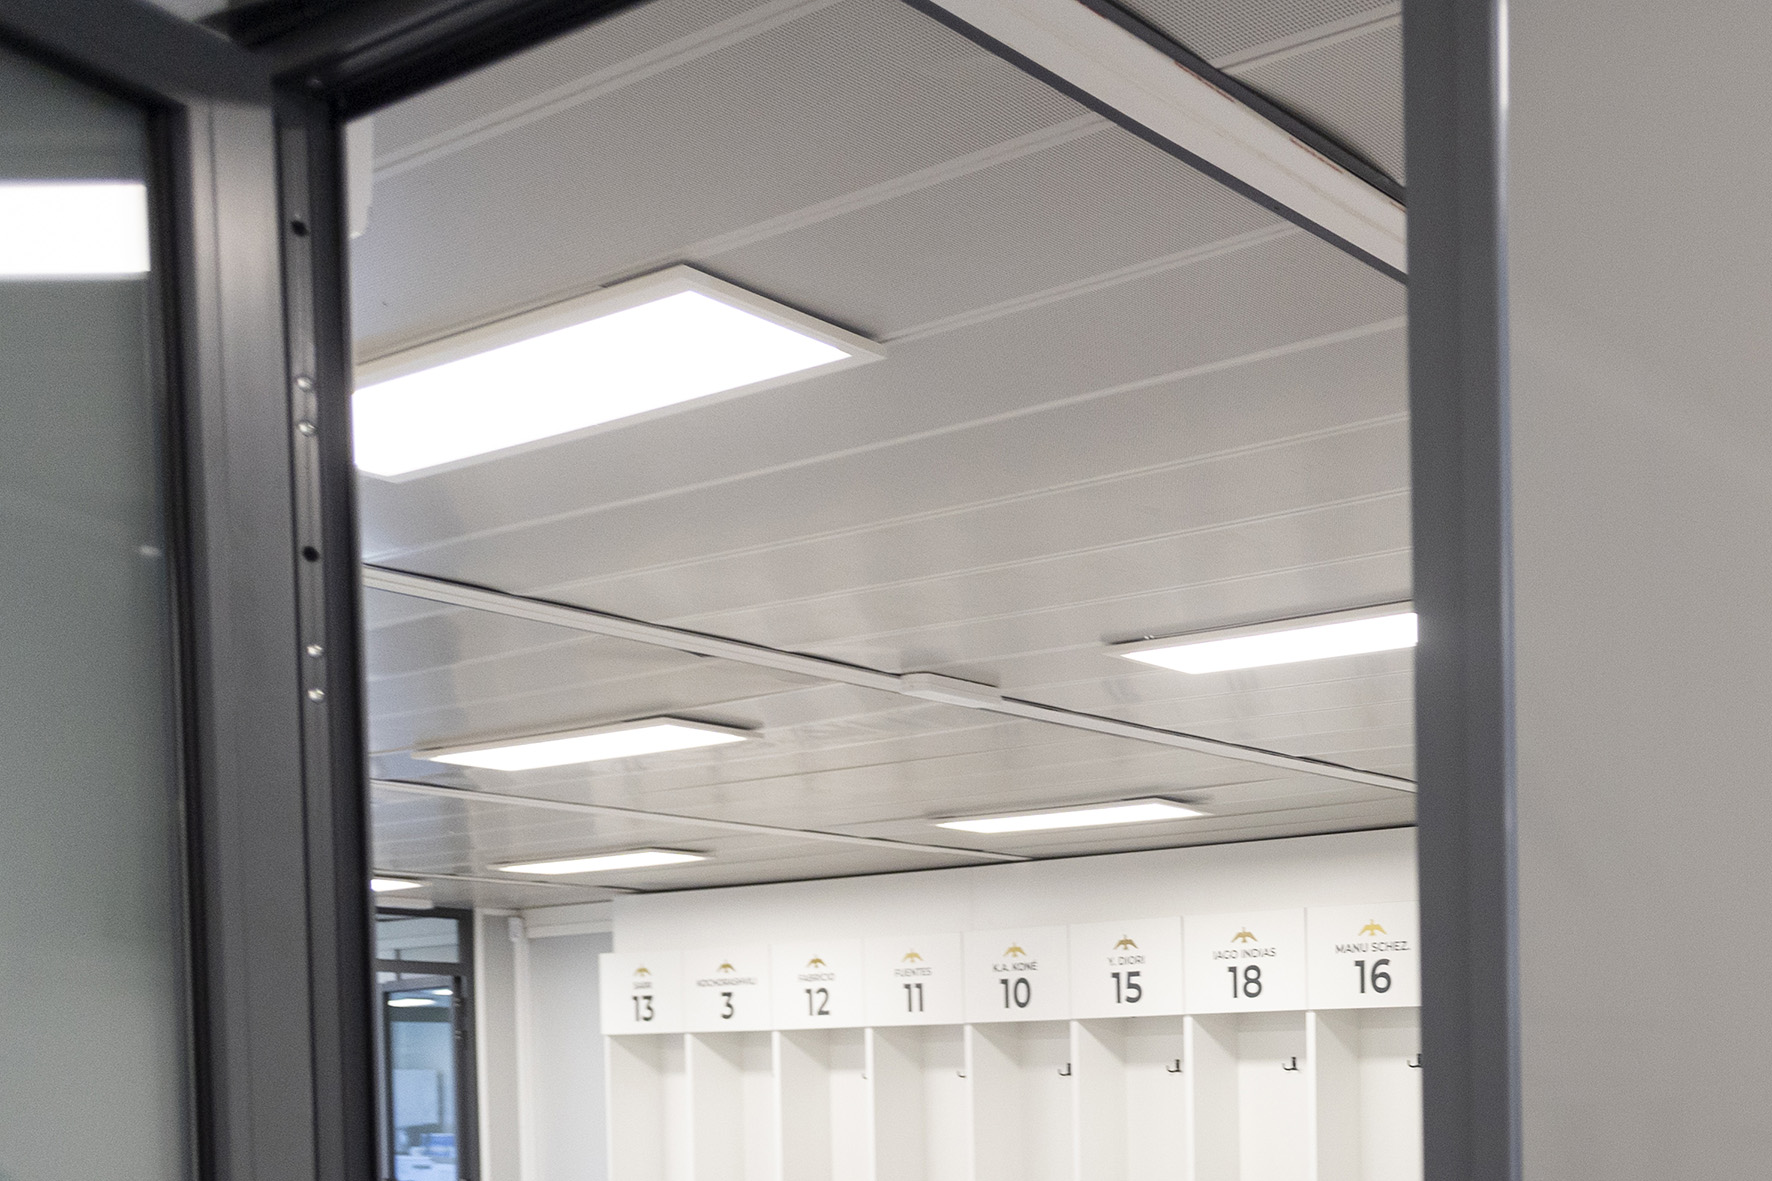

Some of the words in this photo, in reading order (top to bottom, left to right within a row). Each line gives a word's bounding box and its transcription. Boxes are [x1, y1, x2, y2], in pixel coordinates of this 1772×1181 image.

[1212, 949, 1238, 960] IAGO
[1241, 947, 1277, 958] INDIAS
[1335, 942, 1369, 954] MANU
[894, 966, 933, 977] FUENTES
[1110, 970, 1144, 1004] 15
[1226, 964, 1263, 999] 18
[1353, 958, 1393, 994] 16
[632, 994, 655, 1023] 13
[720, 991, 735, 1020] 3
[804, 986, 831, 1017] 12
[902, 981, 924, 1013] 11
[998, 977, 1032, 1009] 10
